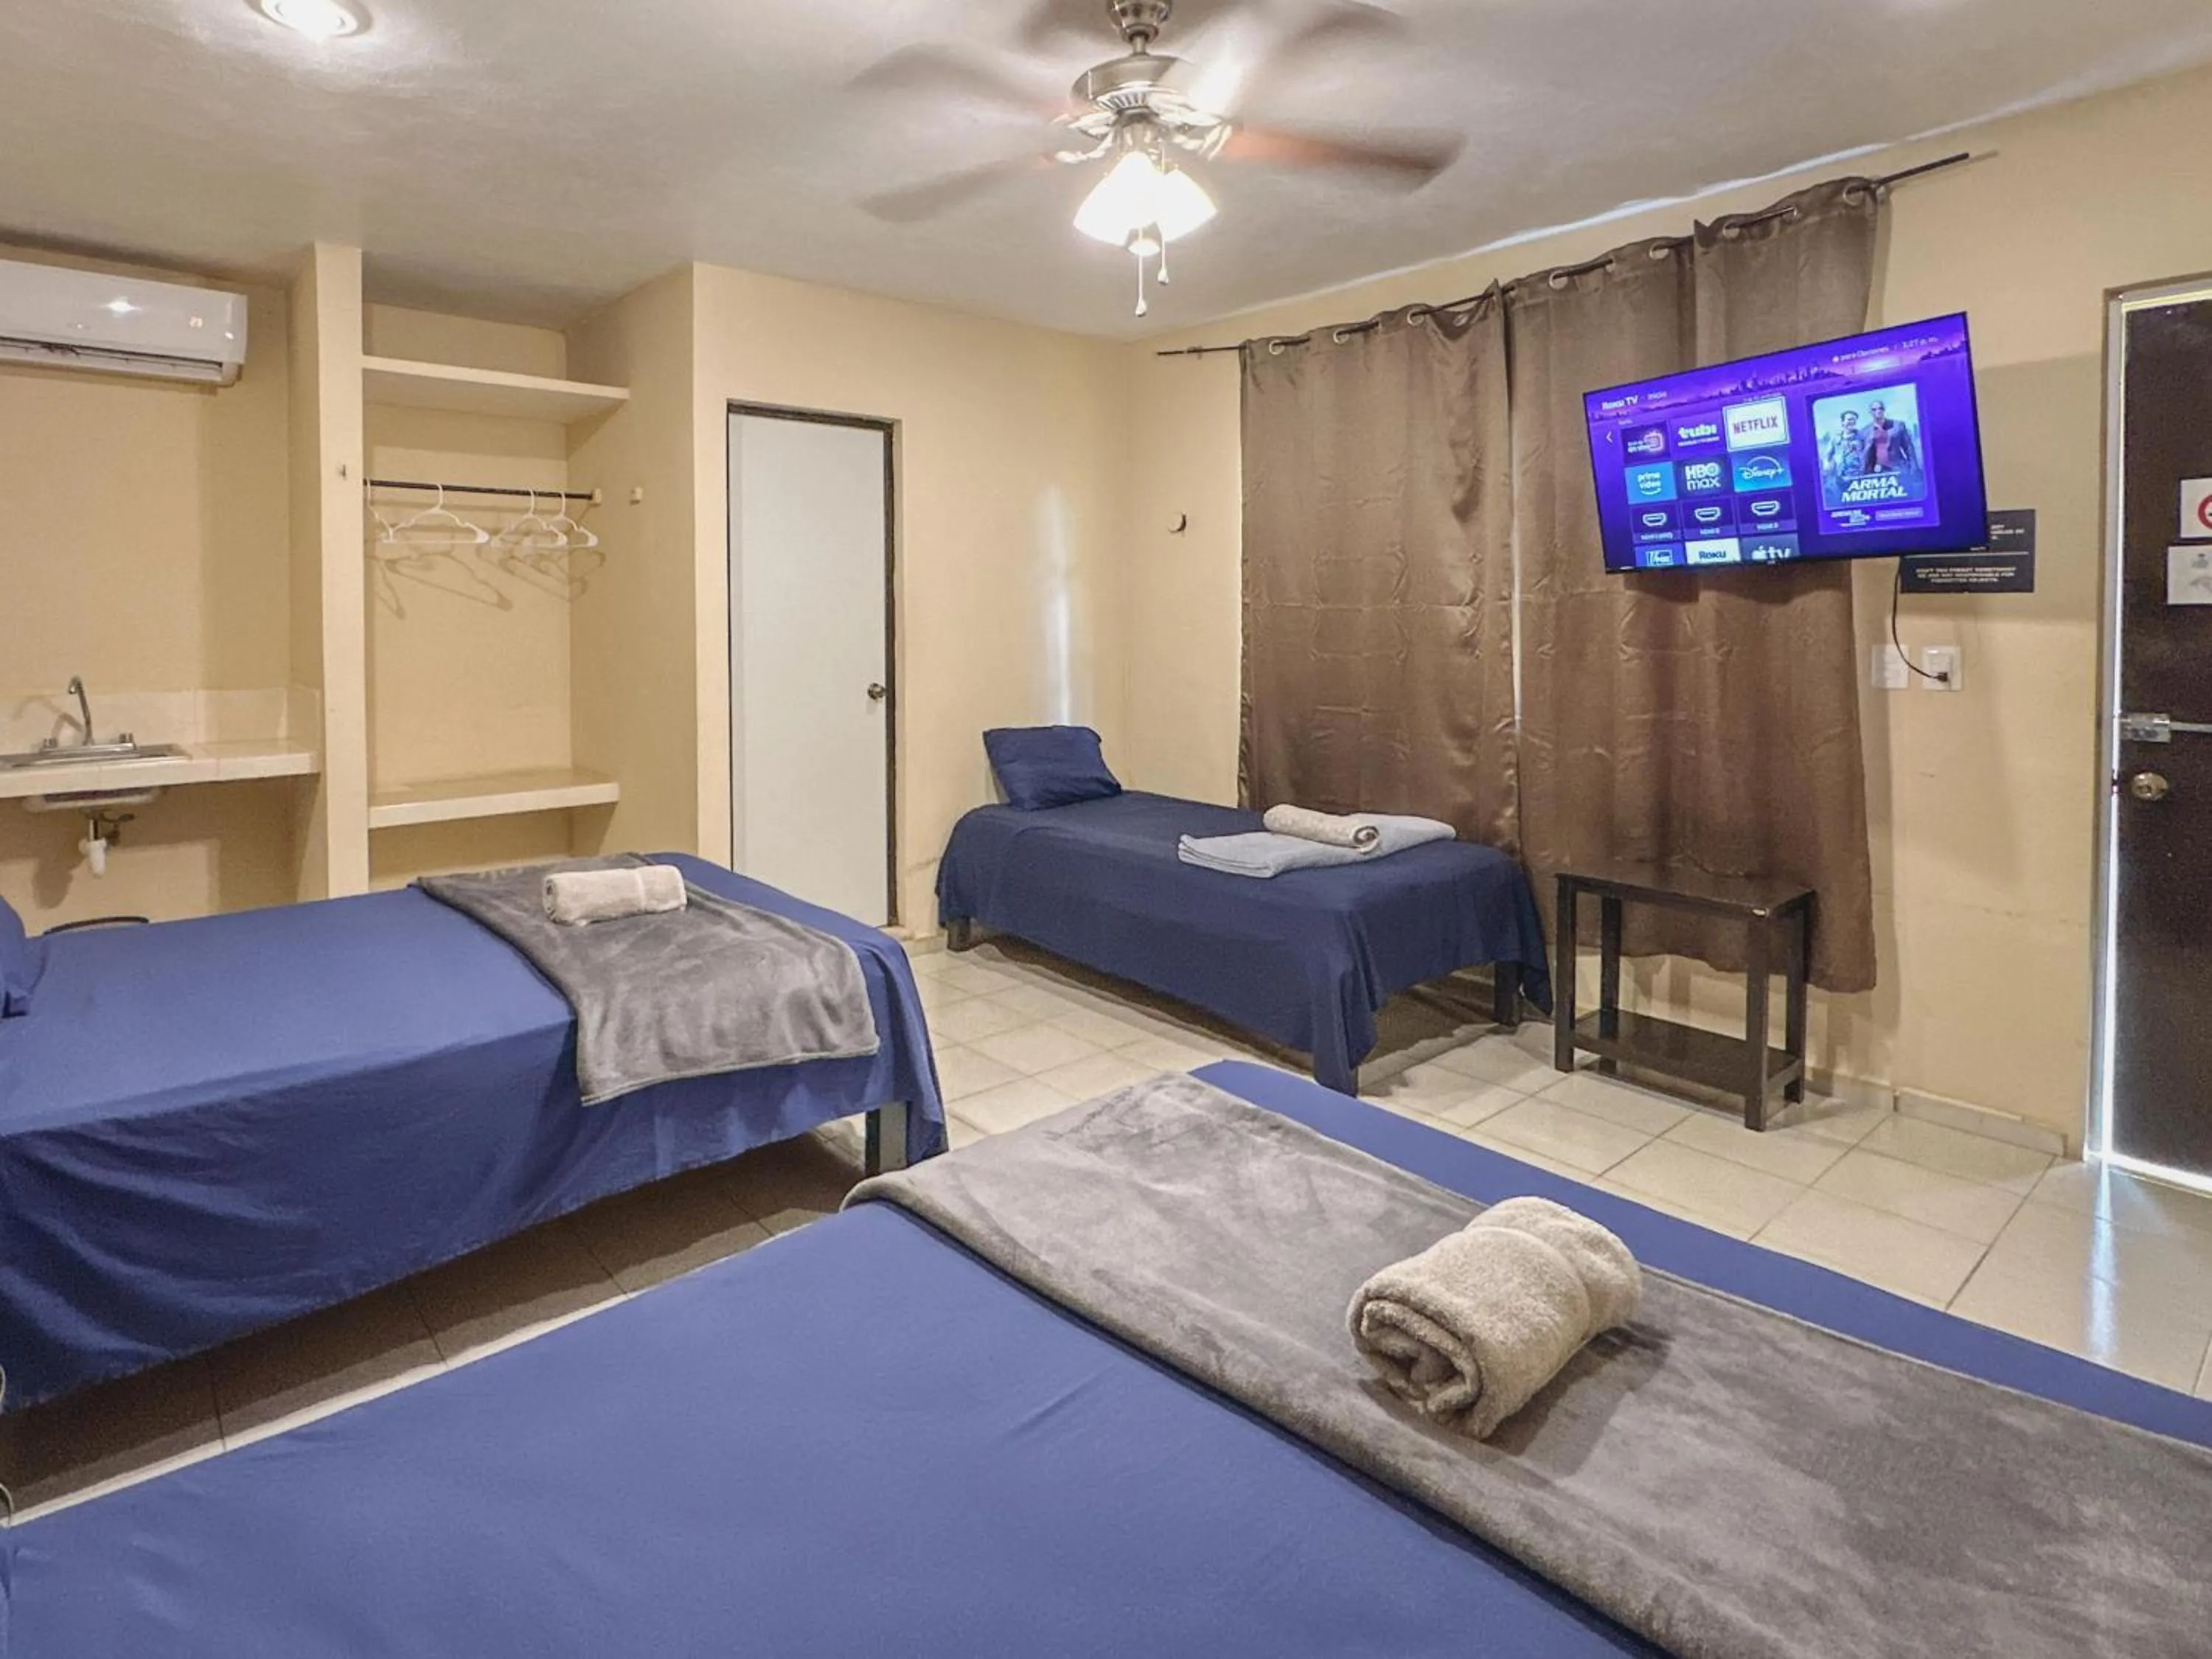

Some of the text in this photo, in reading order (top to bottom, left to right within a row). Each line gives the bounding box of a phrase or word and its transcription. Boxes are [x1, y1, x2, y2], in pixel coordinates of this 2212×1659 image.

[1626, 395, 1638, 405] TV
[1733, 415, 1778, 434] NETFLIX
[1638, 472, 1661, 482] prime
[1685, 462, 1720, 479] HBO
[1686, 477, 1721, 490] max
[1847, 476, 1899, 491] ARMA
[1841, 486, 1907, 502] MORTAL
[1699, 550, 1726, 560] Roku
